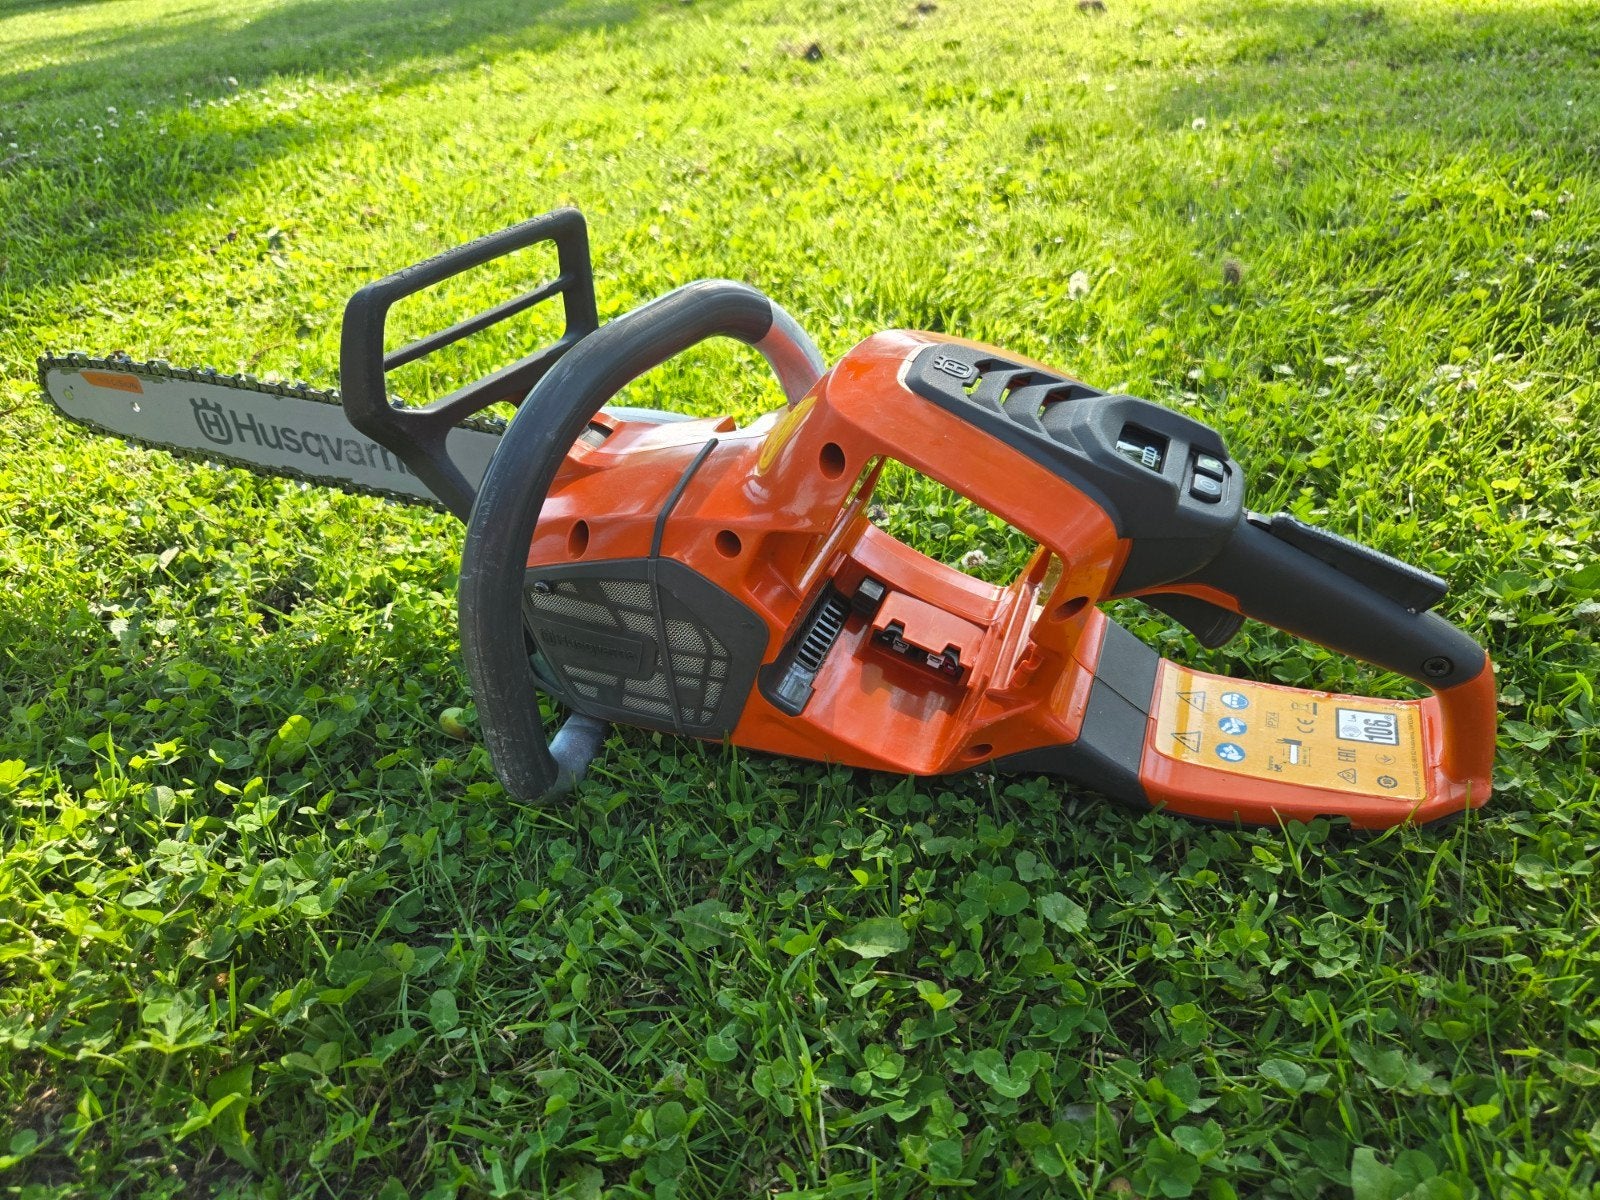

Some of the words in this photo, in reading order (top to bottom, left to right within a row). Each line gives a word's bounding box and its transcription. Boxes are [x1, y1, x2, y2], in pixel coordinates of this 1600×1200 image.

[229, 409, 408, 475] Husqvarn
[1297, 717, 1314, 734] CE
[1363, 718, 1393, 740] 106
[1337, 746, 1356, 763] EAC
